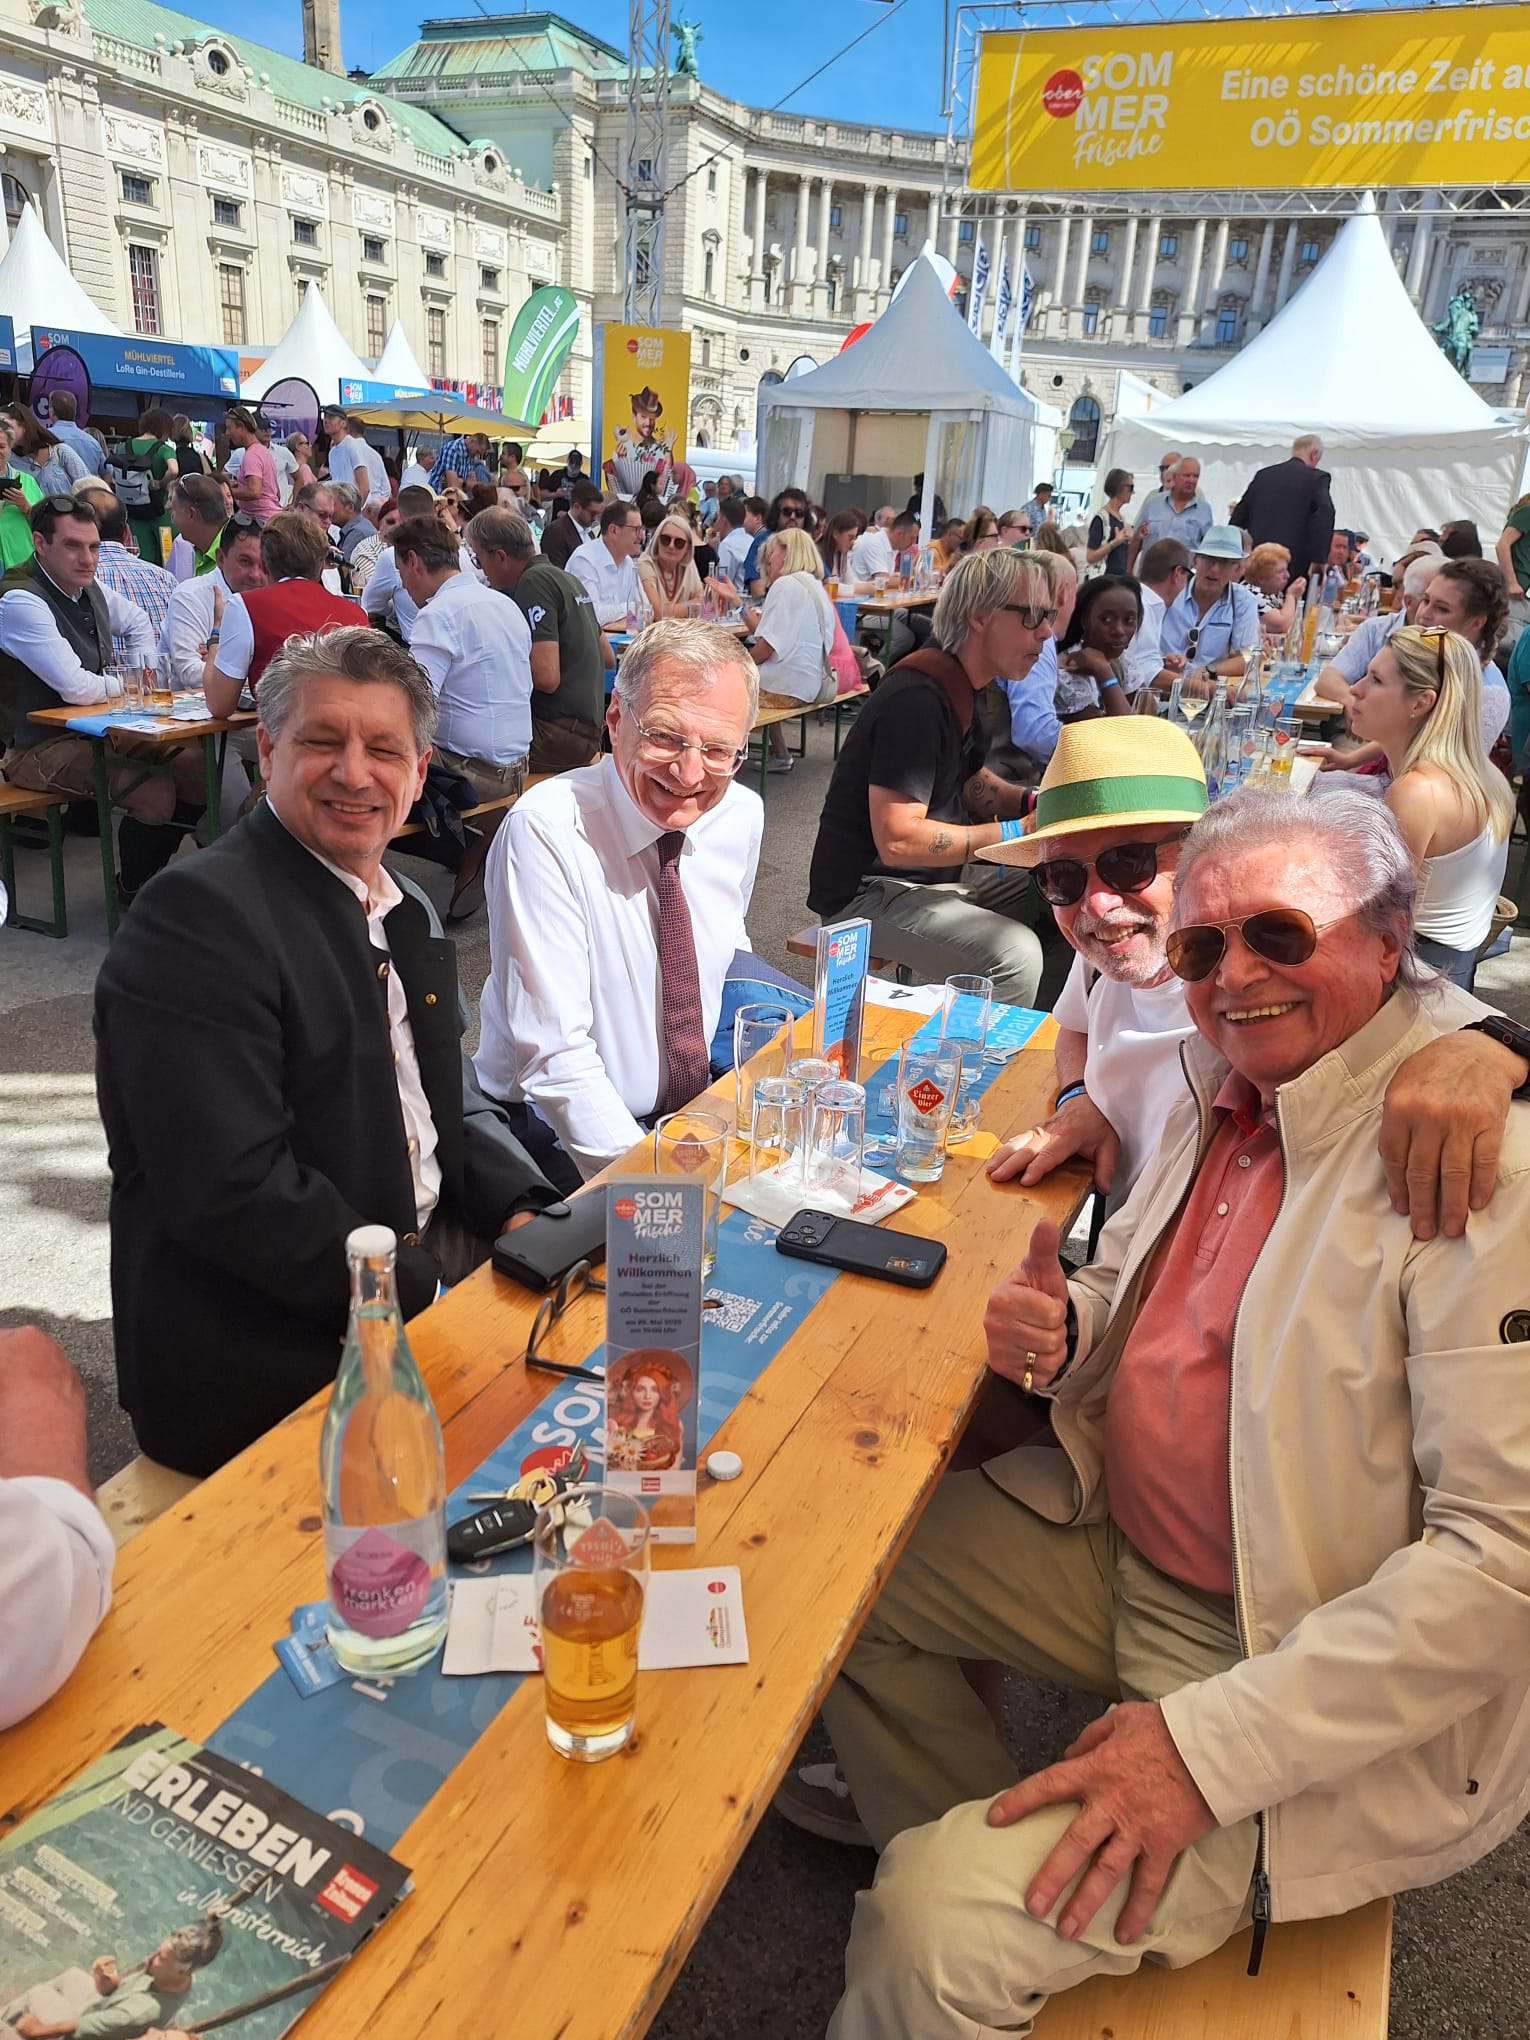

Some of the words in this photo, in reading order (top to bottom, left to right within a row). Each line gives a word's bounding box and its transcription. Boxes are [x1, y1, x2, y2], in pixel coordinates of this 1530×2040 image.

[1082, 51, 1173, 91] SOM
[1220, 68, 1290, 101] Eine
[1296, 63, 1418, 97] schöne
[1424, 58, 1495, 92] Zeit
[1074, 94, 1169, 131] MER
[1250, 109, 1301, 147] OÖ
[1072, 125, 1164, 170] Frische
[124, 350, 176, 366] MÜHLVIERTEL
[136, 365, 186, 380] Gin-Destillerie
[837, 932, 858, 947] SOM
[913, 1089, 940, 1101] Linzer
[634, 1192, 683, 1208] SOM
[633, 1208, 683, 1224] MER
[629, 1253, 681, 1264] Herzlich
[617, 1267, 692, 1278] Willkommen
[120, 1750, 332, 1888] ERLEBEN
[100, 1786, 155, 1826] UND
[151, 1815, 284, 1904] GENIESSEN
[176, 1885, 197, 1903] in
